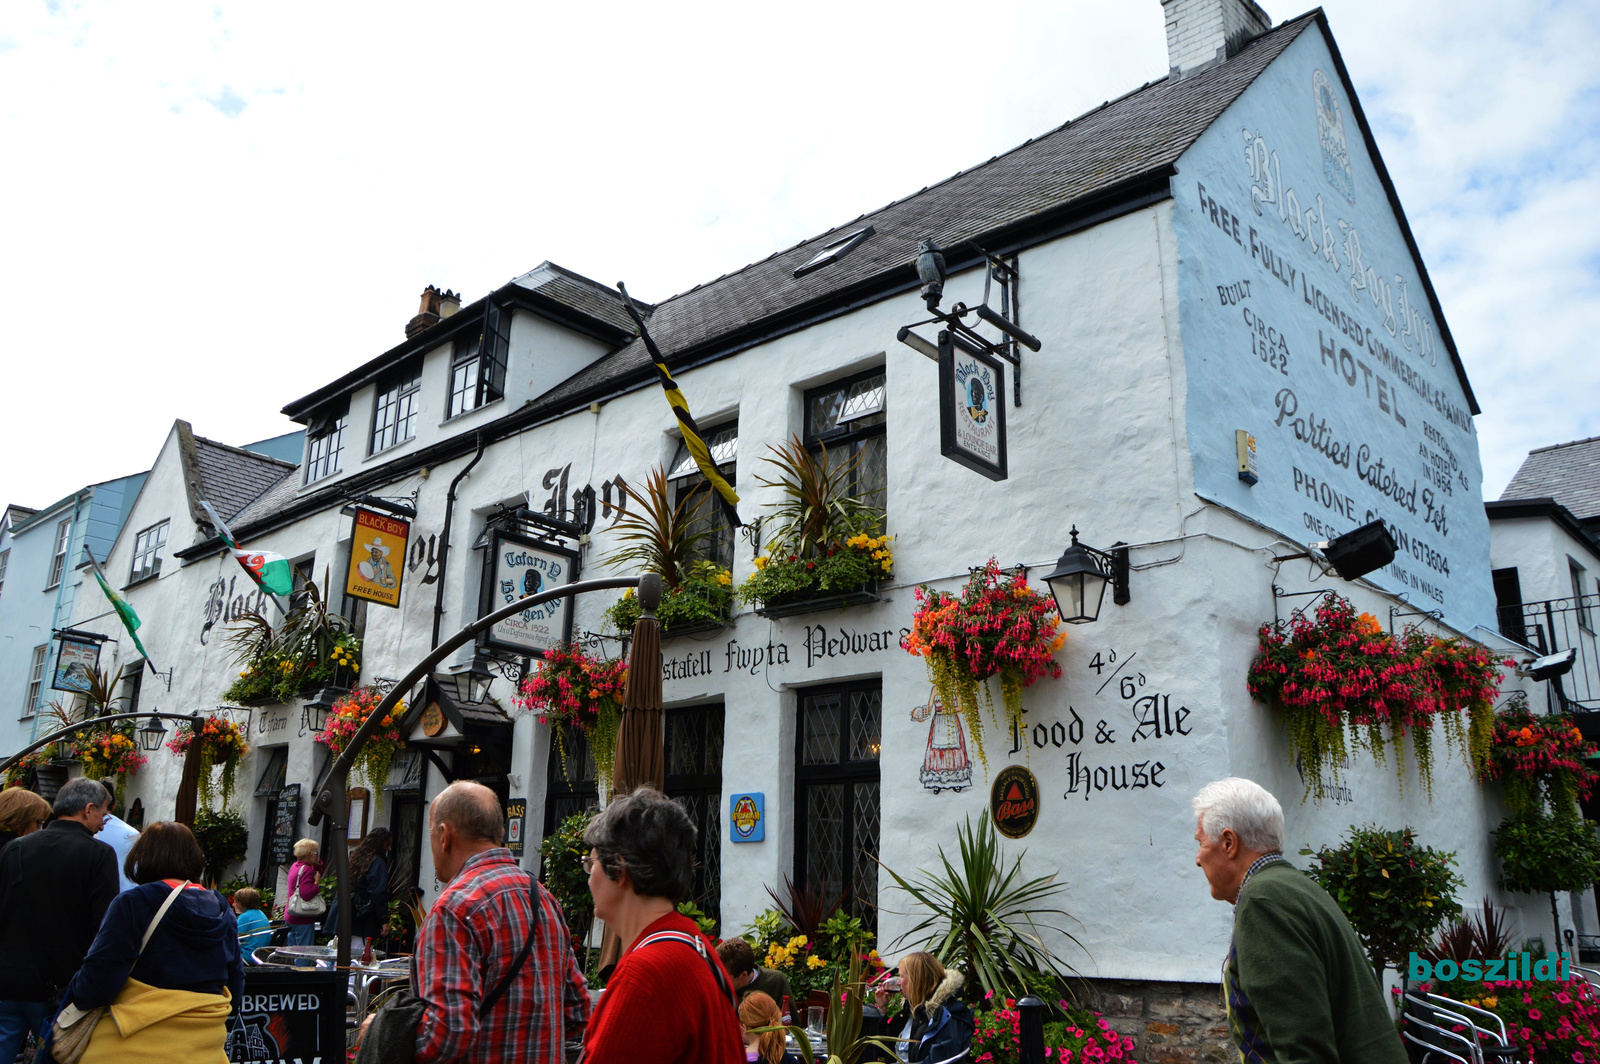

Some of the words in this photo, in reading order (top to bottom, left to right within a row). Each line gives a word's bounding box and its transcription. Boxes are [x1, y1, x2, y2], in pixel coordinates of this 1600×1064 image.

[1242, 128, 1341, 273] Black
[1338, 217, 1397, 339] Boy
[1394, 273, 1437, 368] Inn
[1197, 180, 1249, 254] FREE,
[1248, 224, 1297, 288] FULLY
[1301, 271, 1364, 348] LICENSED
[1365, 327, 1434, 407] COMMERCIAL
[1441, 390, 1472, 435] FAMILY
[1216, 279, 1252, 306] BUILT
[1242, 306, 1290, 355] CIRCA
[1251, 332, 1289, 377] 1522
[955, 360, 981, 391] Black
[980, 366, 996, 402] Boy
[1318, 329, 1407, 428] HOTEL
[957, 400, 996, 439] RESTAURANT
[1273, 387, 1352, 470] Parties
[962, 430, 985, 450] LOUNGE
[984, 441, 998, 456] BAR
[963, 440, 992, 460] ENTRANCE
[1418, 441, 1429, 460] AN
[1430, 449, 1453, 480] HOTEL
[1422, 420, 1458, 472] RESTORED
[1458, 470, 1469, 492] AS
[1356, 443, 1418, 516] Catered
[1422, 487, 1449, 537] For
[1422, 461, 1432, 481] IN
[1431, 467, 1453, 498] 1954
[358, 513, 386, 531] BLACK
[386, 523, 404, 535] BOY
[1303, 512, 1325, 537] ONE
[408, 529, 446, 588] oy
[504, 551, 548, 571] Tafarn
[1411, 537, 1450, 579] 673604
[352, 584, 372, 595] FREE
[372, 589, 394, 601] HOUSE
[1390, 561, 1409, 586] INNS
[1410, 573, 1419, 591] IN
[1419, 578, 1444, 605] WALES
[504, 617, 529, 630] CIRCA
[530, 624, 550, 635] 1522
[660, 649, 712, 682] stafell
[802, 623, 894, 669] Pedwar
[1094, 718, 1117, 745] &
[1131, 692, 1193, 743] Ale
[507, 804, 525, 819] BASS
[996, 797, 1034, 822] Bass
[241, 993, 320, 1013] BREWED
